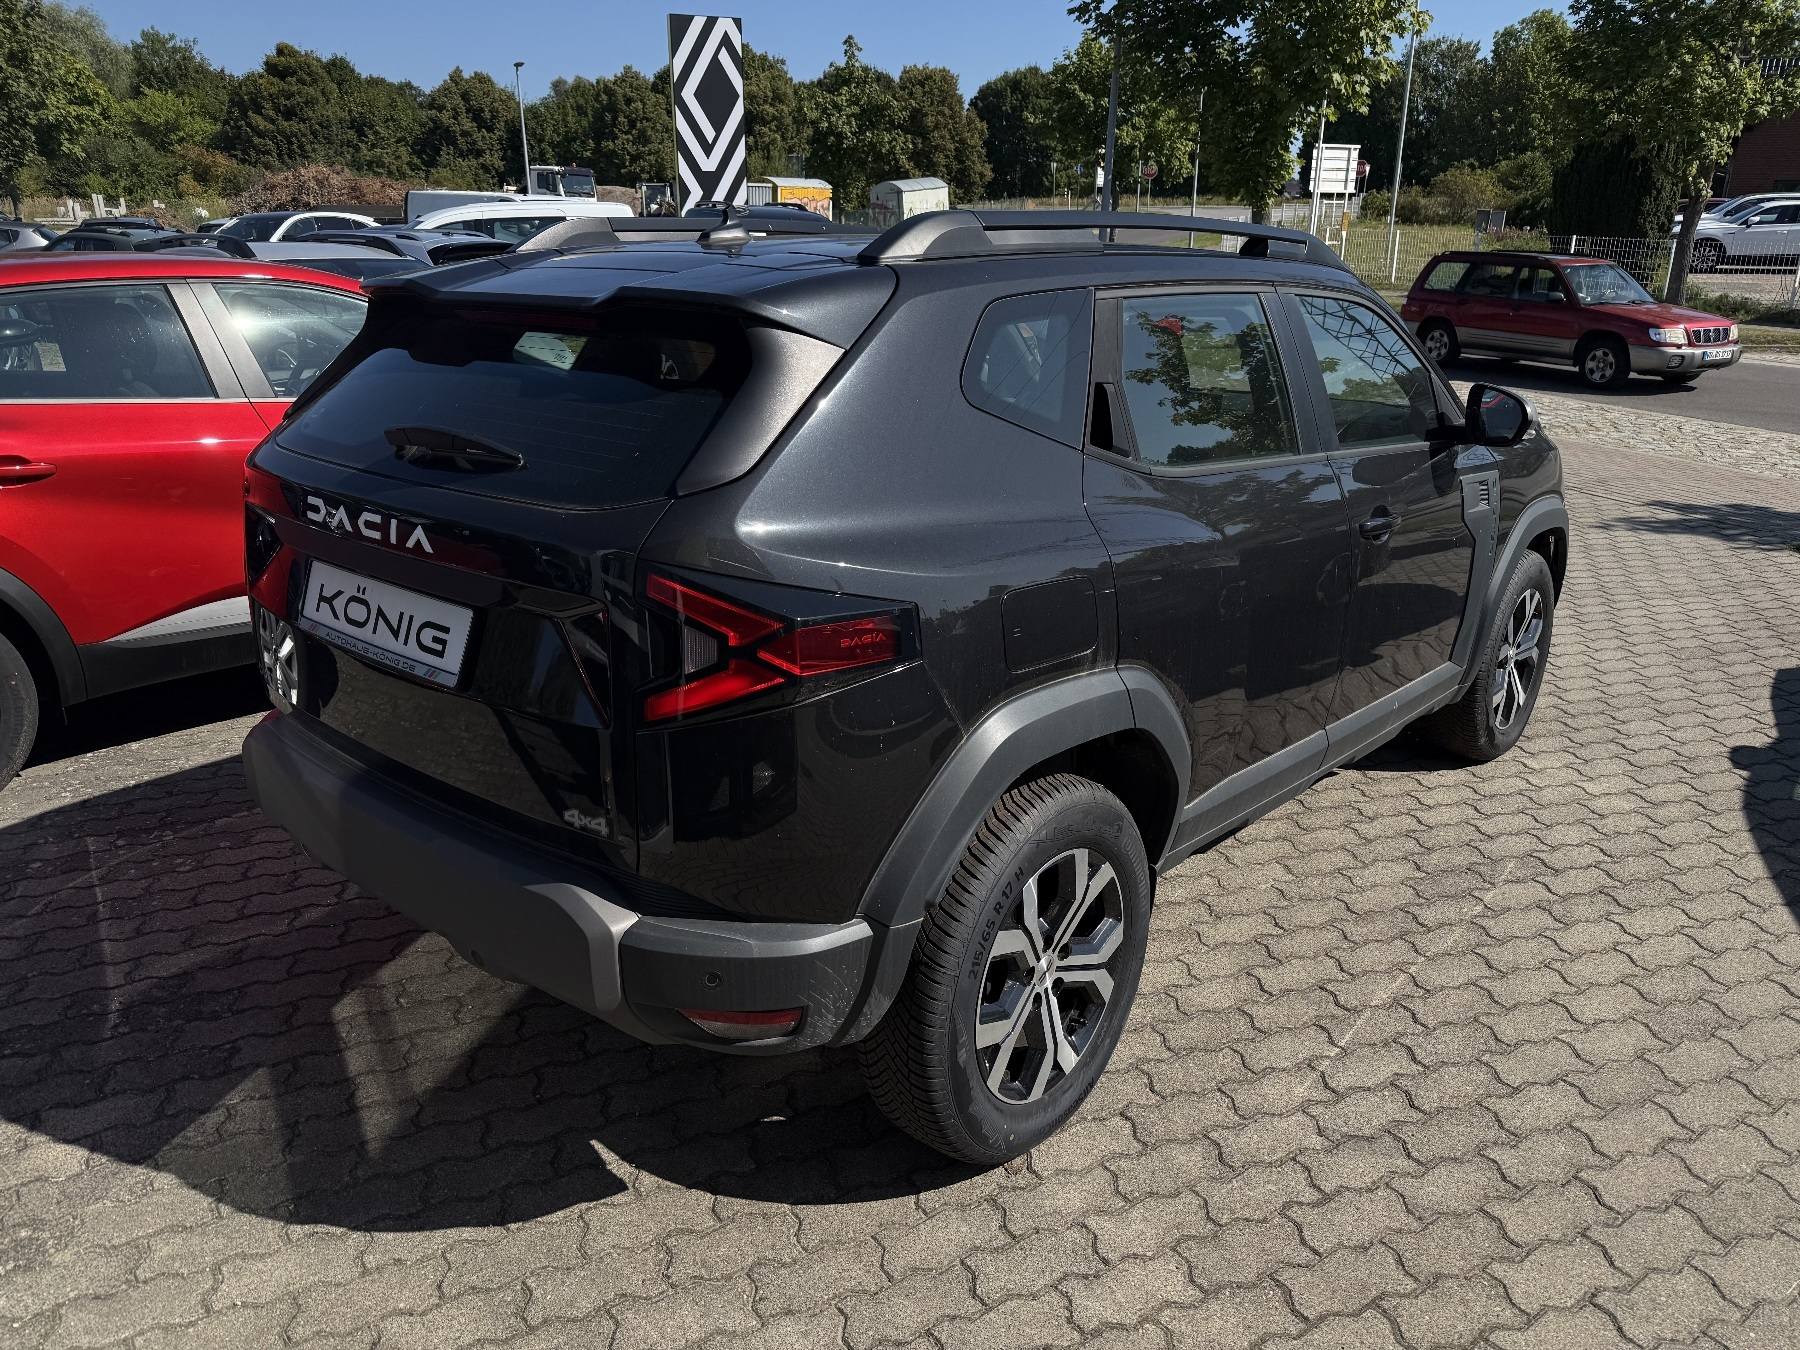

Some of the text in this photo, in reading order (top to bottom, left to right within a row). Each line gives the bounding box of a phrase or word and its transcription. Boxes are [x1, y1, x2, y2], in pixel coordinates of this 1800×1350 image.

[306, 495, 434, 554] DACIA
[315, 583, 451, 659] KÖNIG
[840, 632, 888, 648] DACIA
[967, 918, 995, 980] 215/65
[993, 901, 1004, 916] R
[1001, 881, 1013, 900] 17
